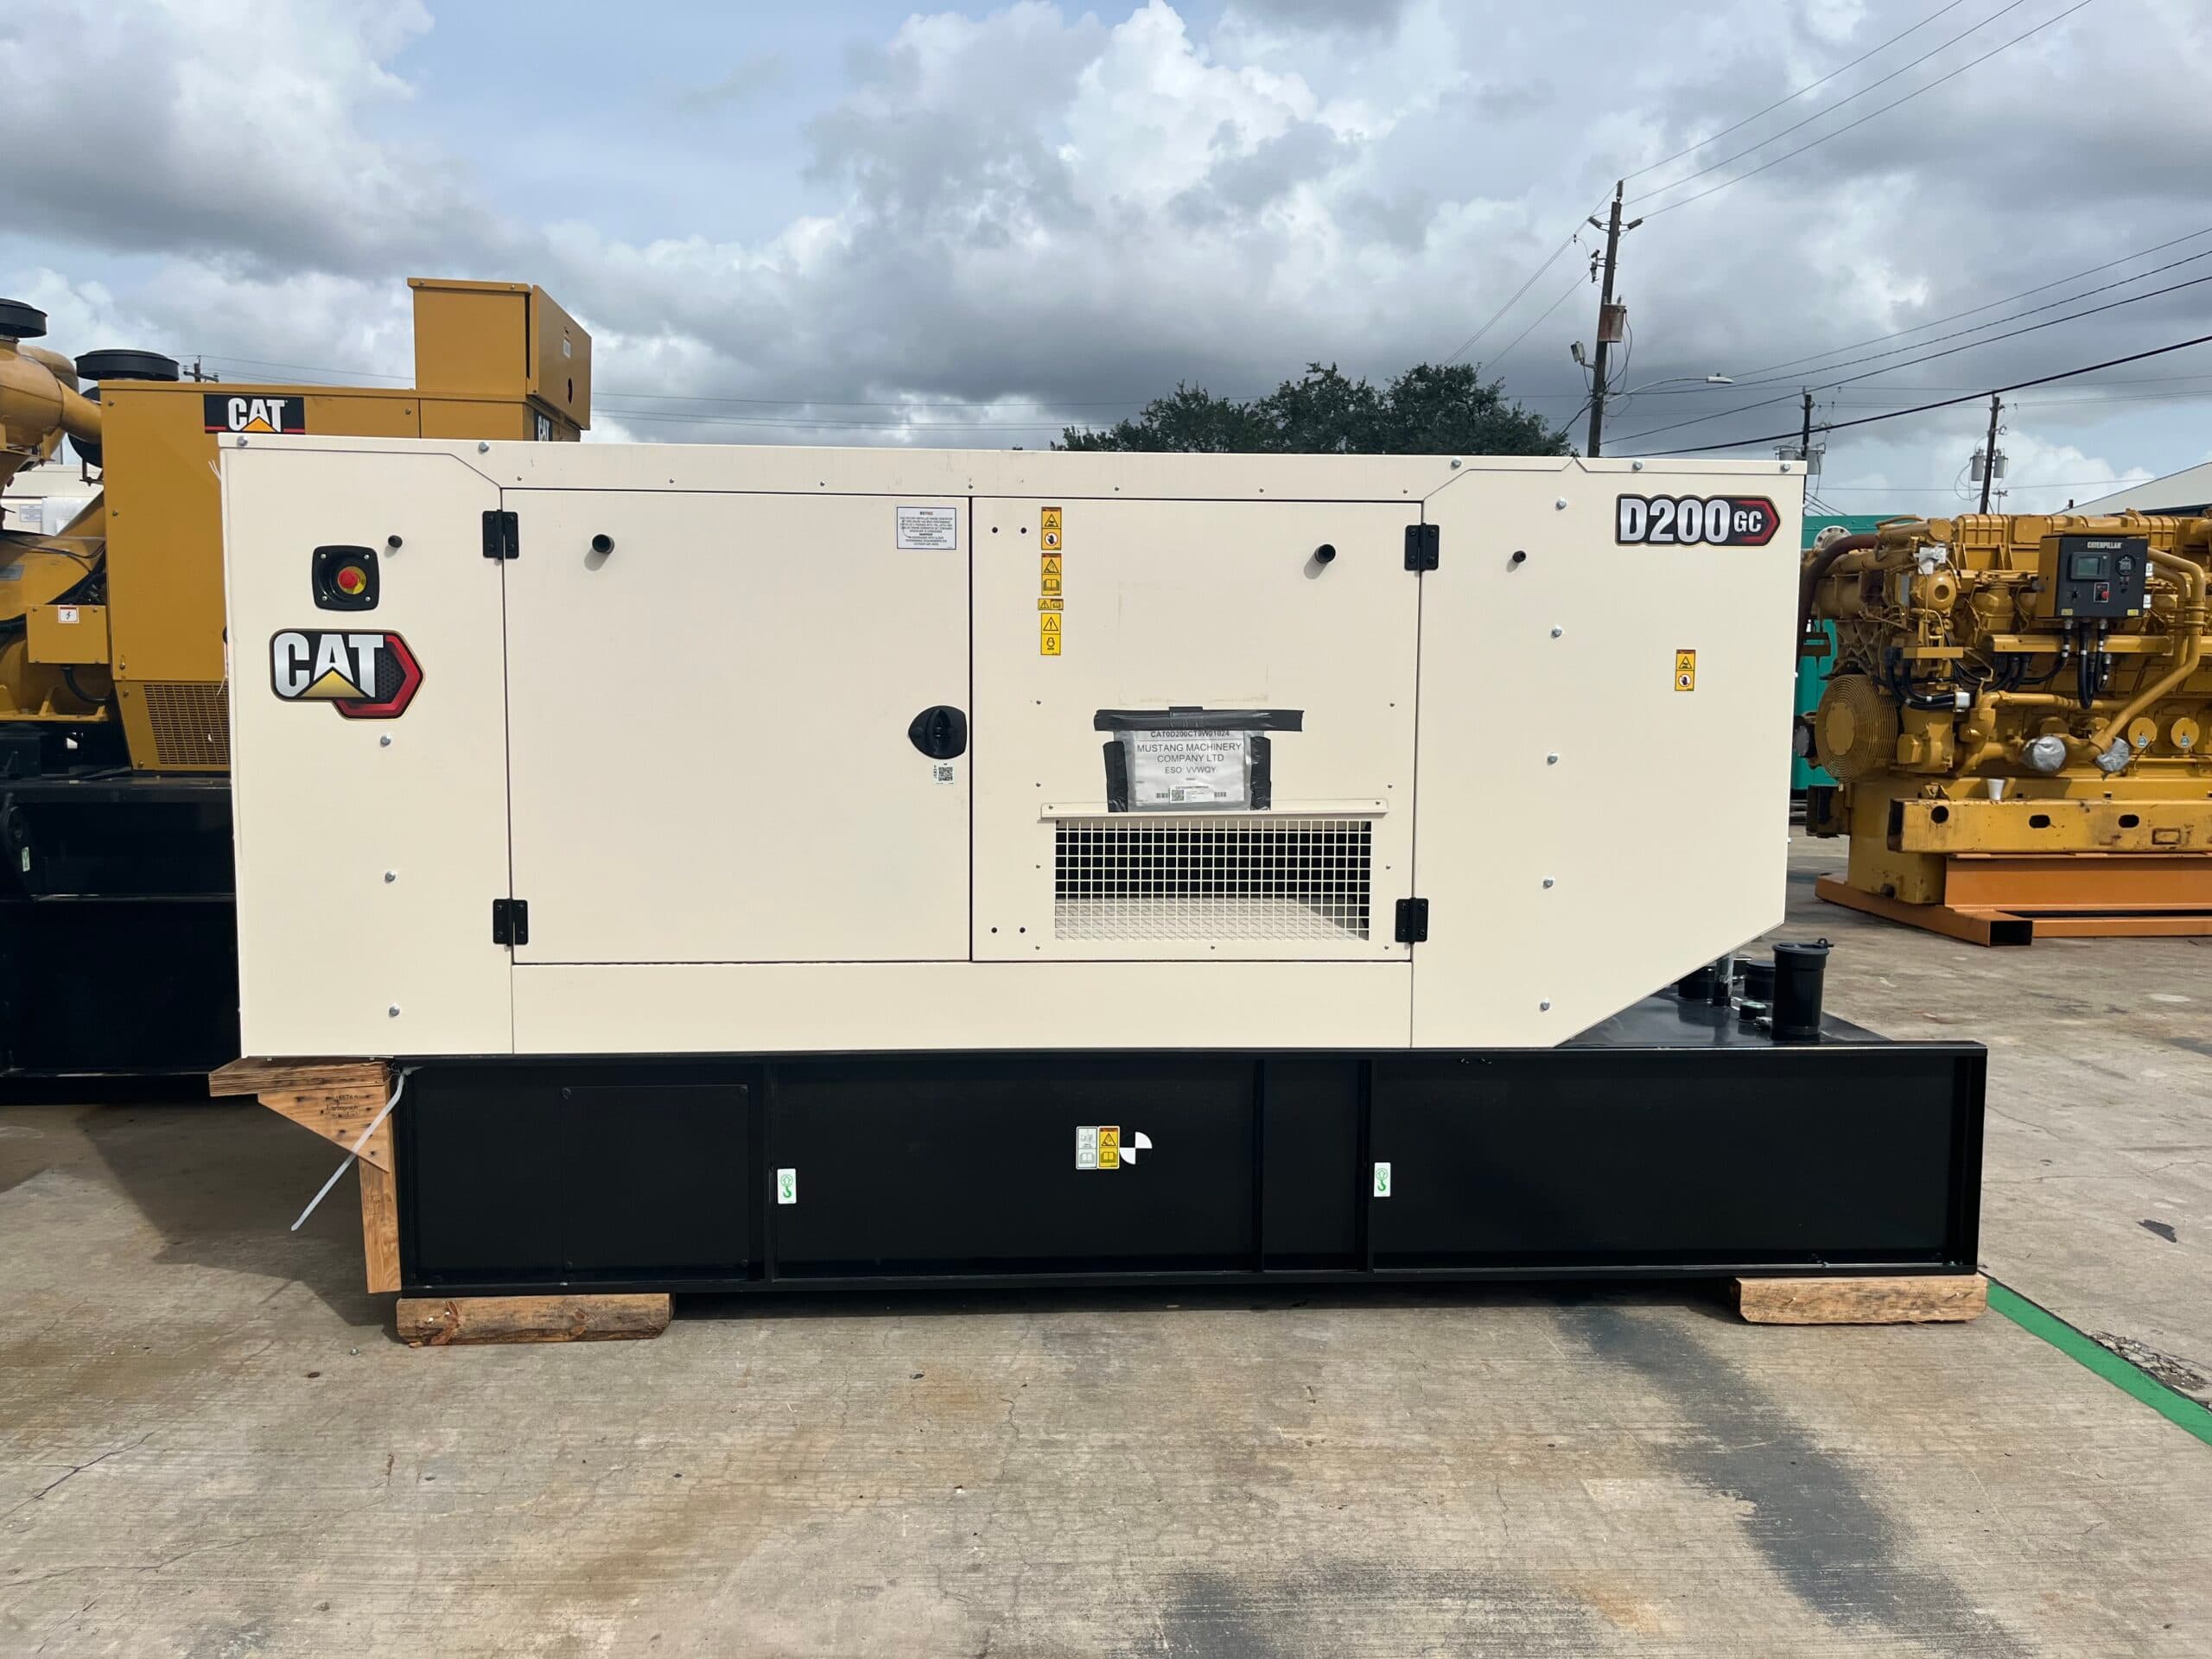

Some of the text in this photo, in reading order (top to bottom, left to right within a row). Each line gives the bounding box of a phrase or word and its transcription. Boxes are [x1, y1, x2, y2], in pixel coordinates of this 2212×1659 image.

[228, 397, 286, 433] CAT
[1620, 498, 1763, 543] D200 GC
[2087, 541, 2123, 550] CATERPILLAR
[273, 632, 384, 698] CAT
[1137, 742, 1242, 753] MUSTANG MACHINERY
[1157, 754, 1205, 763] COMPANY
